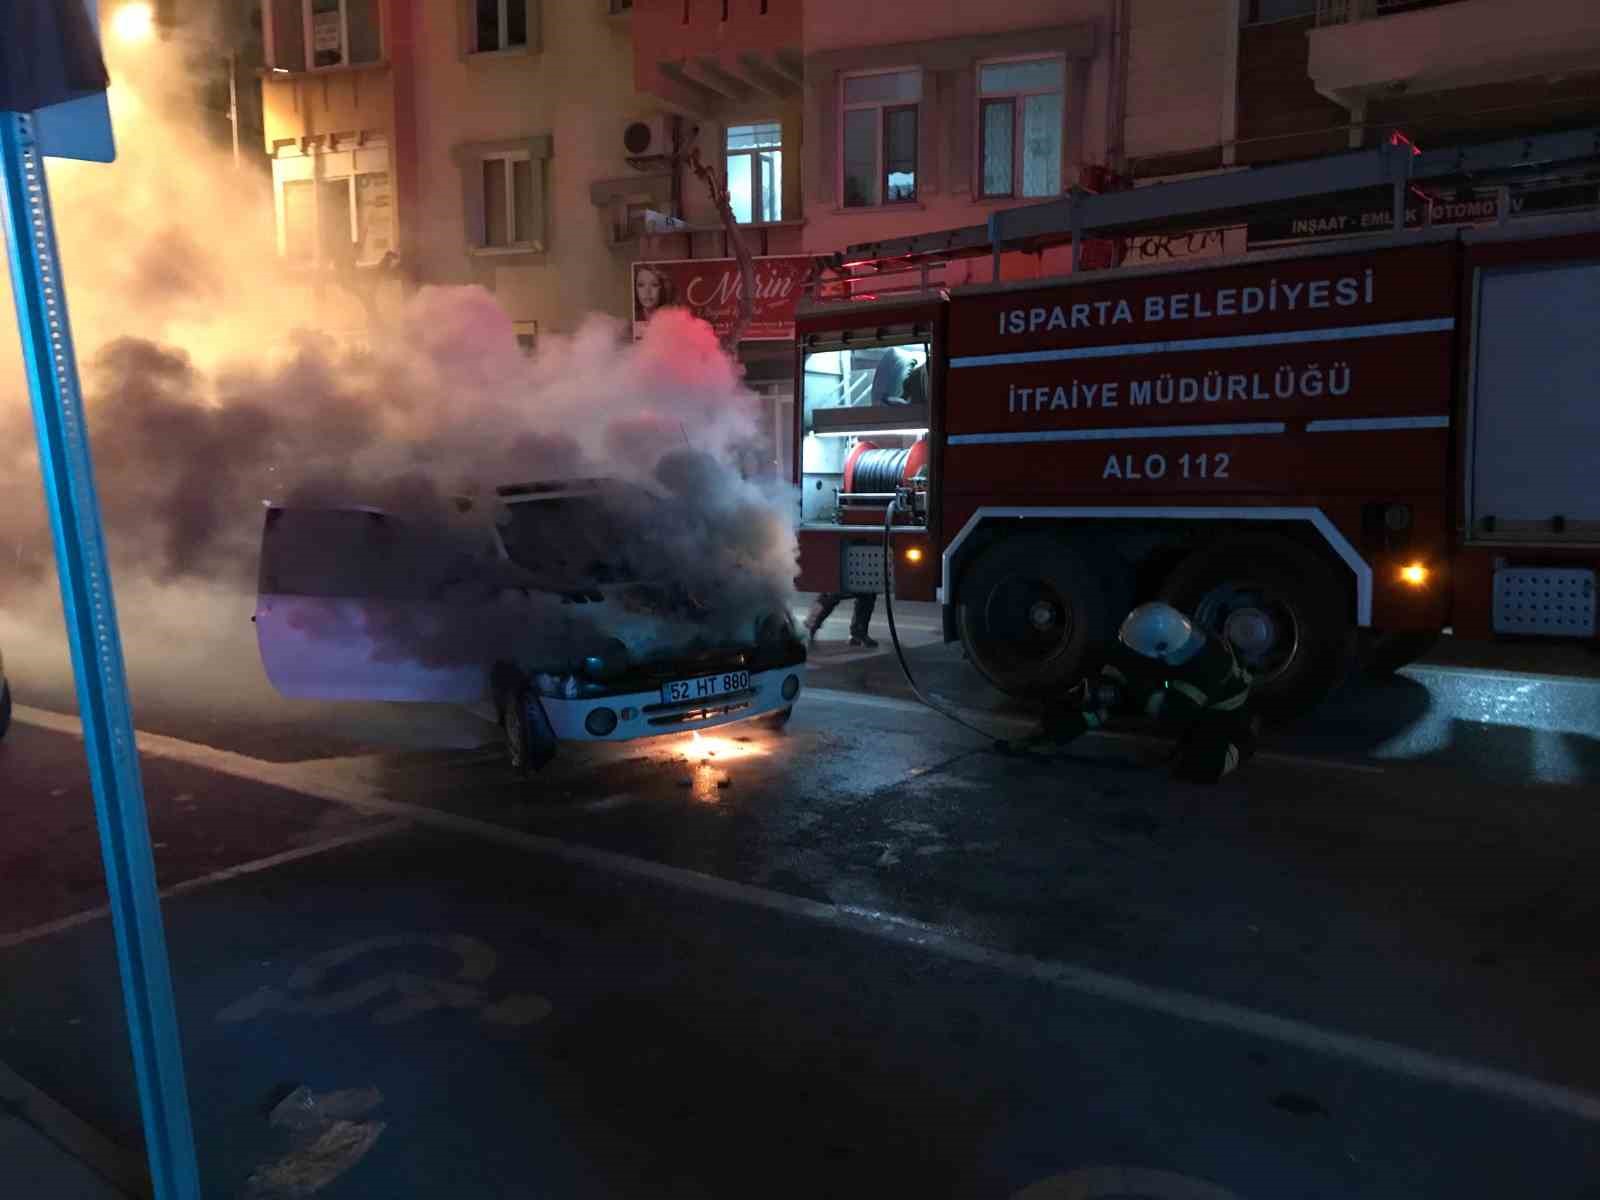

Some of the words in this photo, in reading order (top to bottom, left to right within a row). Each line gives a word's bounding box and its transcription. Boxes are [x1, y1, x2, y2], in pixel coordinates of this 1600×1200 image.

[1361, 207, 1416, 226] EMLK
[998, 298, 1133, 336] ISPARTA
[1143, 268, 1376, 322] BELEDİYESİ
[1007, 378, 1120, 414] İTFAİYE
[1128, 360, 1353, 408] MÜDÜRLÜĞÜ
[1102, 453, 1168, 481] ALO
[1178, 451, 1231, 480] 112
[671, 681, 689, 700] 52
[697, 676, 717, 696] HT
[723, 671, 748, 691] 880
